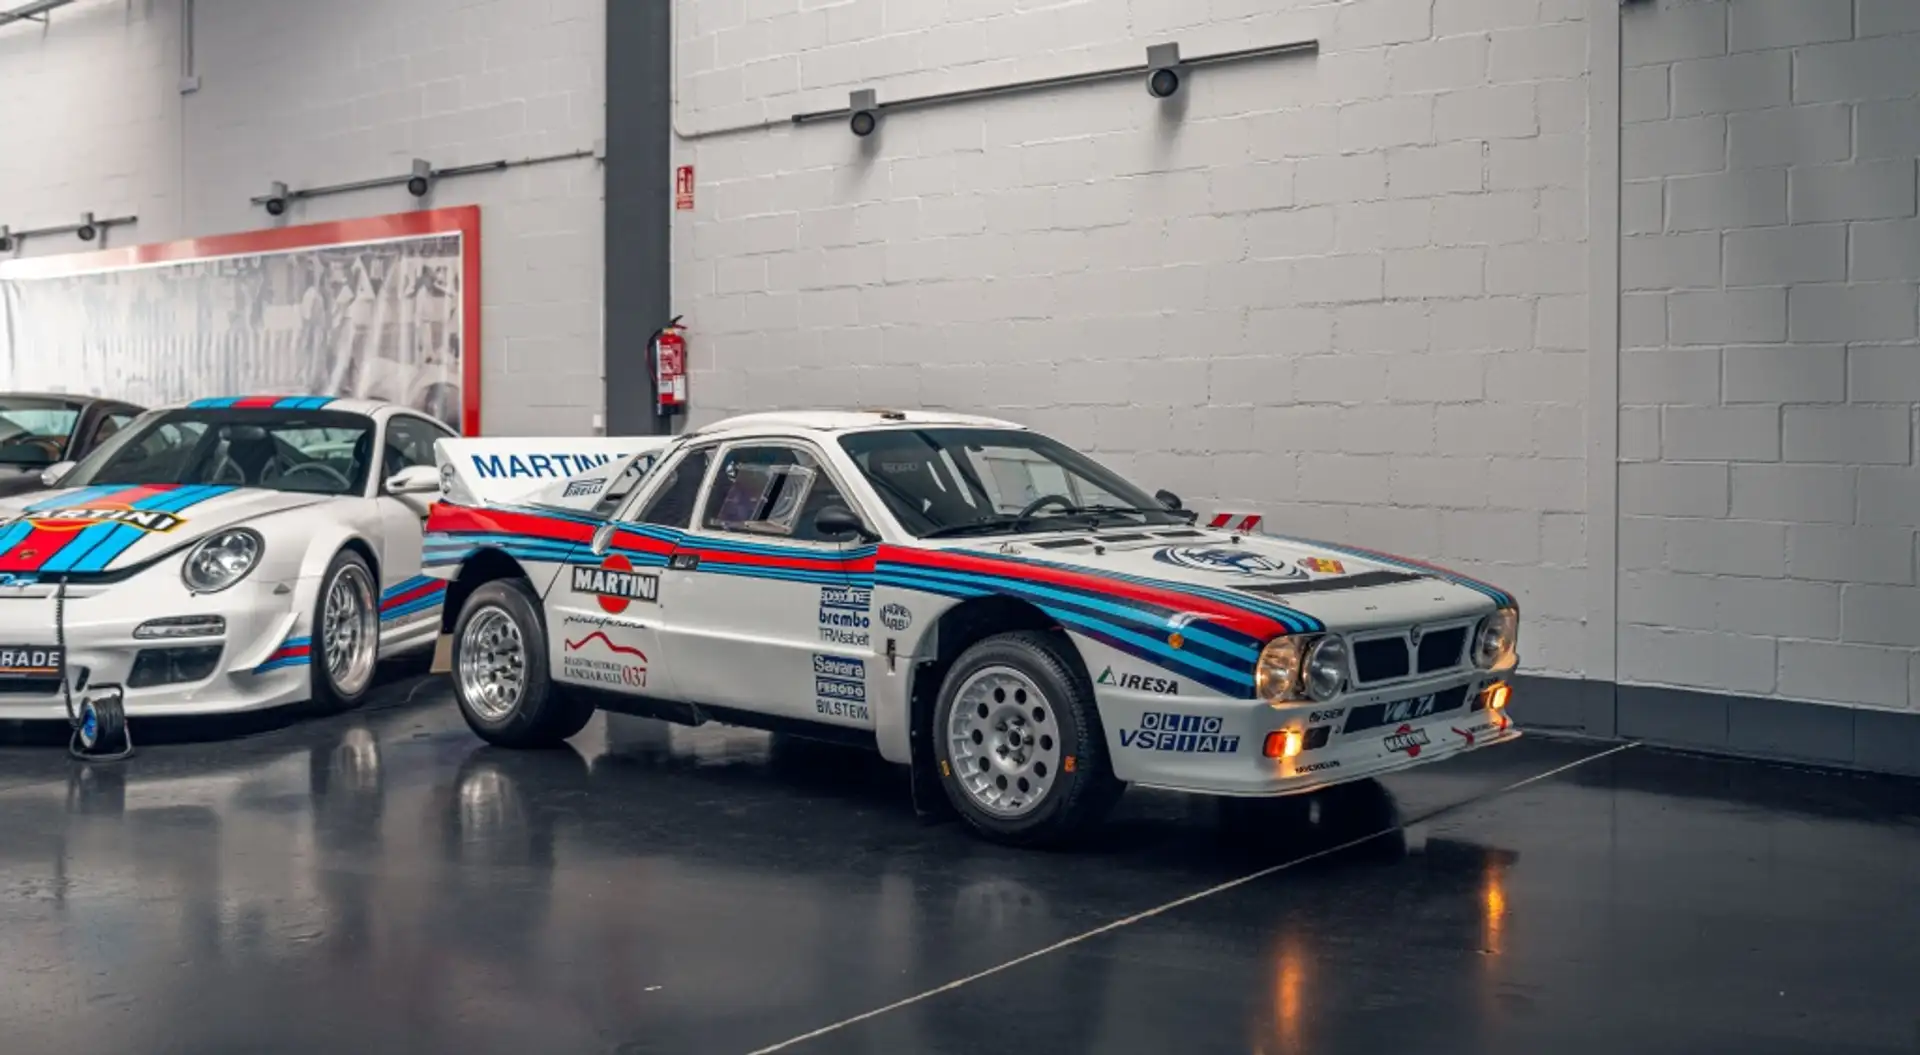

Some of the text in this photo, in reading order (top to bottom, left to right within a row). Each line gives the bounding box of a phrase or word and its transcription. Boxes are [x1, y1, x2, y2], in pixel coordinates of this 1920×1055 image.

[573, 567, 657, 599] MARTINI
[819, 607, 870, 629] brembo
[622, 664, 647, 688] 037
[814, 656, 864, 676] Savara
[816, 699, 870, 720] BILSTEIN
[1142, 712, 1223, 733] OLIO
